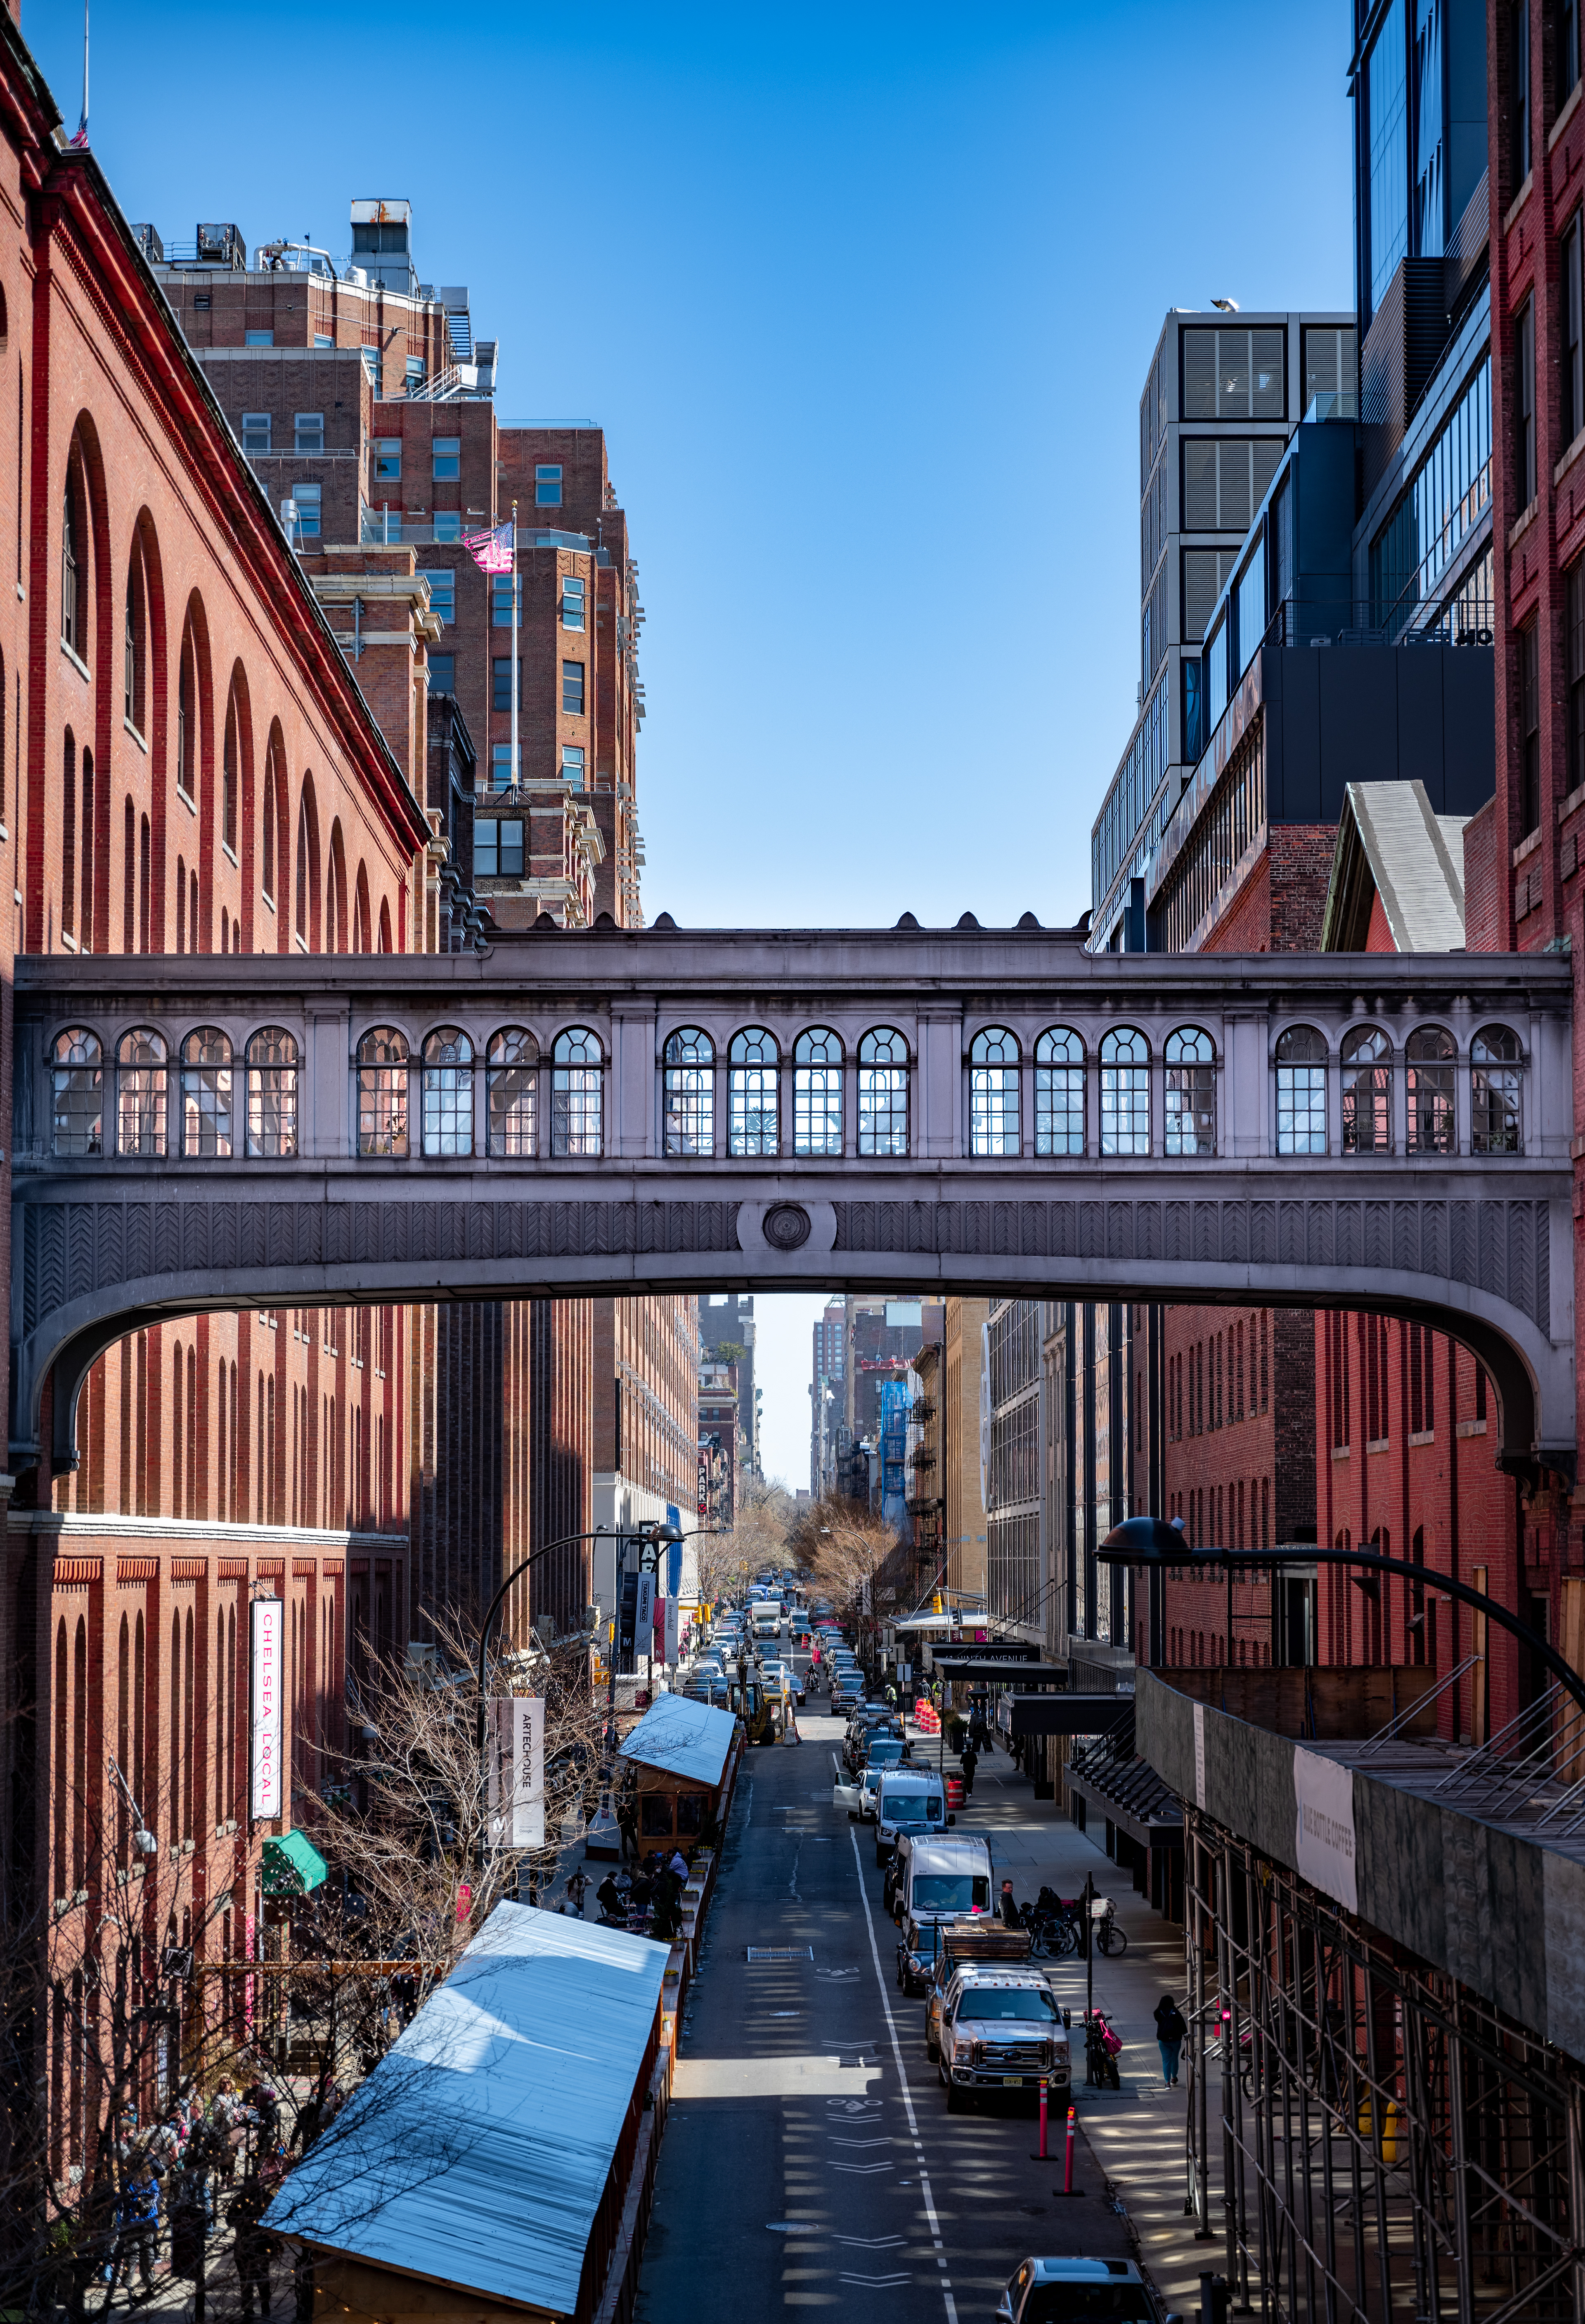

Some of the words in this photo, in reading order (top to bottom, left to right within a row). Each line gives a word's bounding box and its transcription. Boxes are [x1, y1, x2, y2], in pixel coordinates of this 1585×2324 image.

[641, 1525, 656, 1573] PAR
[263, 1614, 272, 1717] CHELSEA
[262, 1733, 272, 1804] LOCAL
[523, 1714, 531, 1787] ARTECHOUSE
[1303, 1803, 1313, 1834] BLUE
[1314, 1809, 1330, 1845] BOTTLE
[1332, 1820, 1352, 1858] COFFEE
